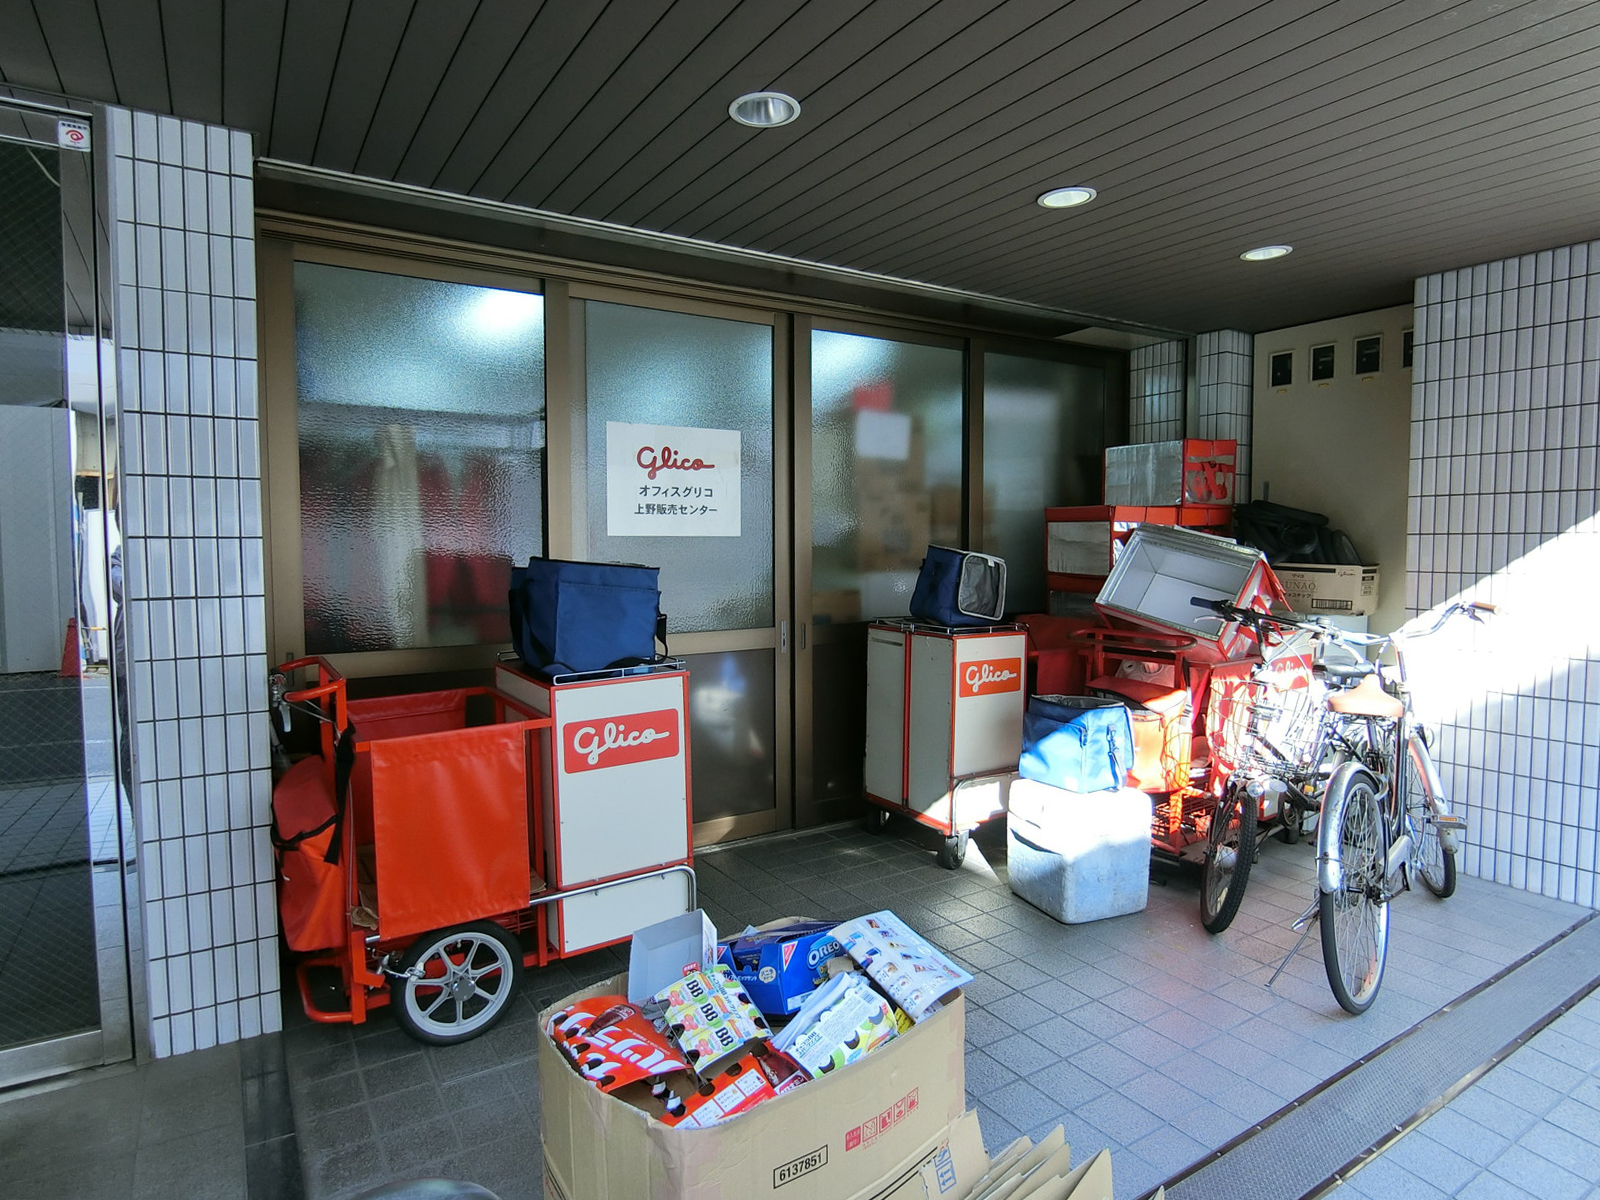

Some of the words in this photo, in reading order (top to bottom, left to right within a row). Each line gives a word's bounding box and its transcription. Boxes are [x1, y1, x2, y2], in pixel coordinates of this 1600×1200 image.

[637, 446, 715, 480] Glico
[638, 485, 713, 498] オフィスグリコ
[634, 503, 718, 515] 上野販売センター
[965, 663, 1017, 693] Glico
[573, 722, 670, 765] Glico
[808, 941, 840, 966] OREO
[686, 979, 704, 998] BB
[700, 1002, 719, 1022] BB
[715, 1026, 734, 1047] BB
[779, 1152, 823, 1182] 6137851
